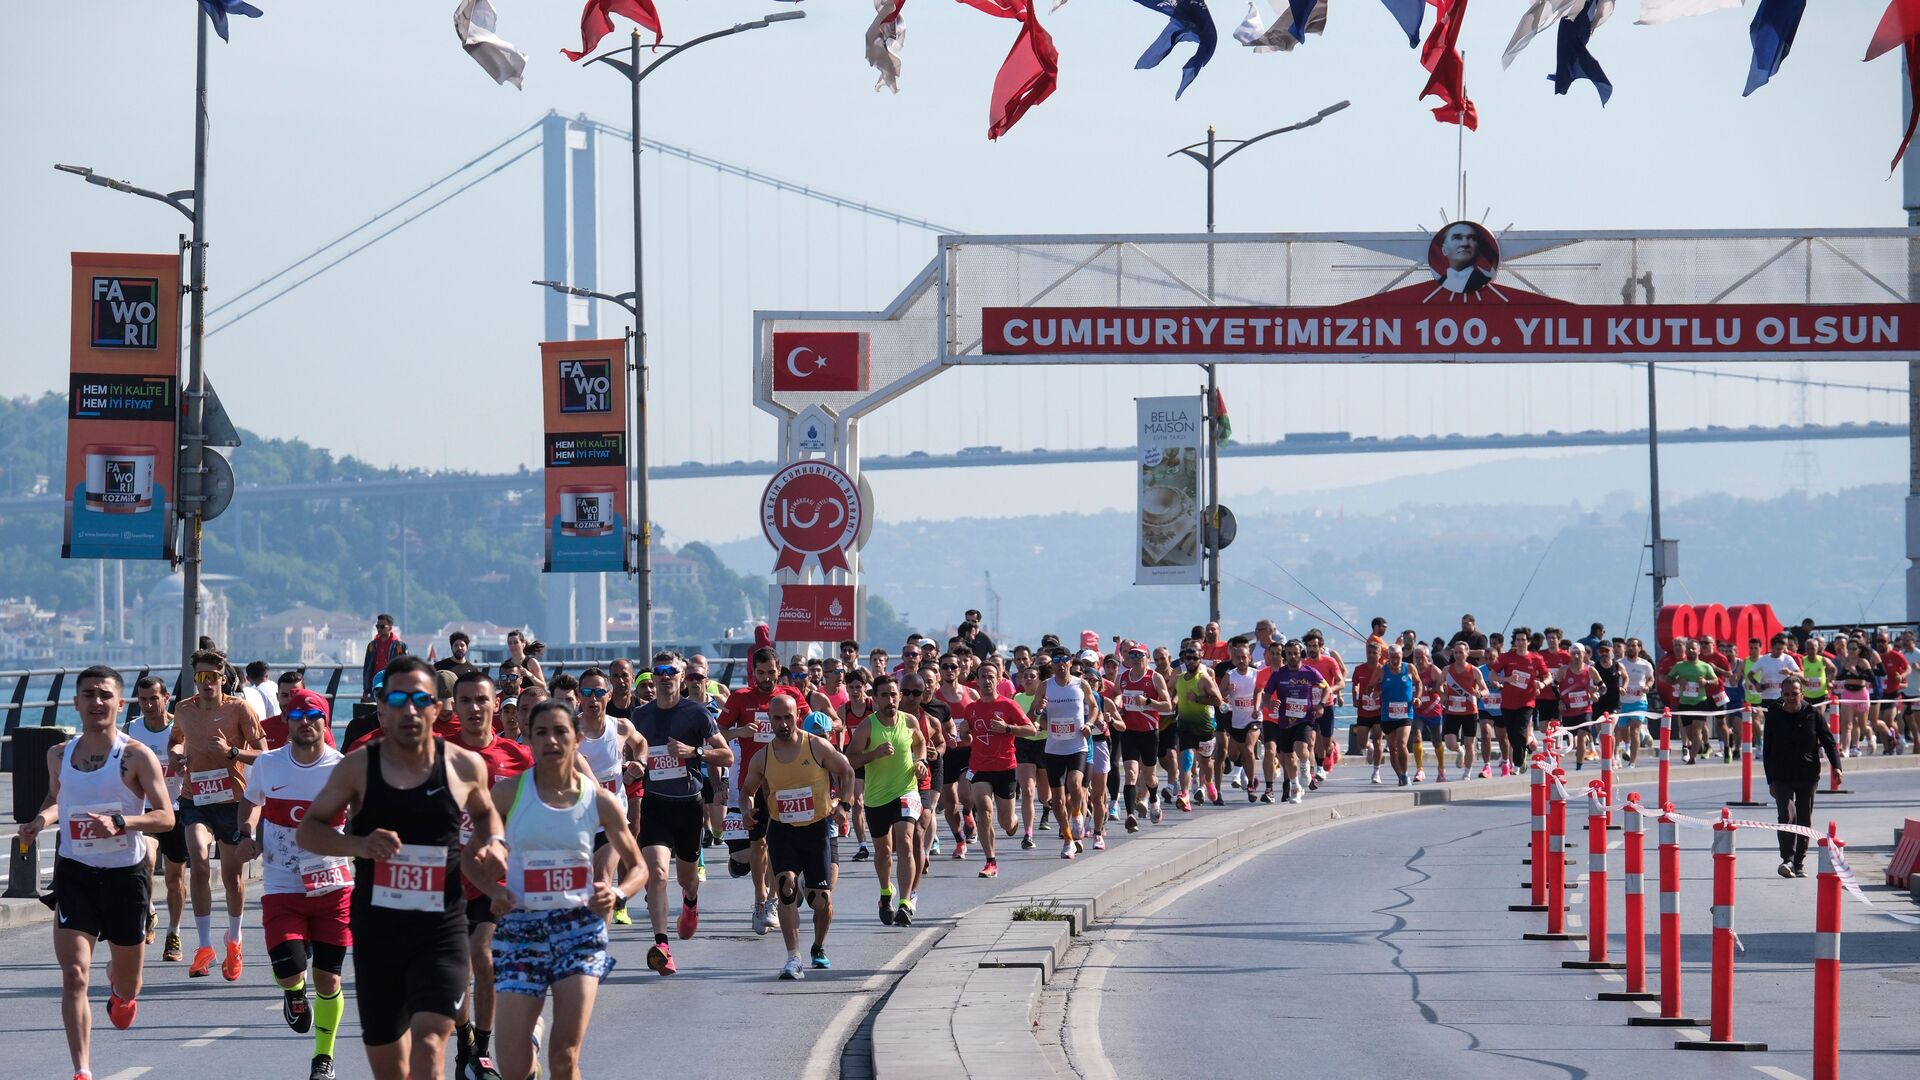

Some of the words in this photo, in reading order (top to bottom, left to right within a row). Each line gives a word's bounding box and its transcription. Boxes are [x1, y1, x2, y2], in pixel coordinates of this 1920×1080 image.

[1415, 317, 1501, 346] 100.
[1514, 318, 1592, 346] YILI
[1607, 317, 1741, 345] KUTLU
[1755, 315, 1899, 345] OLSUN
[83, 385, 108, 395] HEM
[109, 383, 123, 396] İYİ
[125, 384, 162, 396] KALİTE
[83, 398, 107, 409] HEM
[109, 397, 123, 409] İYİ
[125, 397, 153, 409] FİYAT
[1151, 411, 1188, 422] BELLA
[1144, 422, 1195, 434] MAISON
[556, 441, 575, 449] HEM
[576, 440, 587, 448] İYİ
[588, 439, 617, 448] KALİTE
[556, 451, 575, 459] HEM
[576, 450, 587, 458] İYİ
[589, 450, 610, 458] FİYAT
[782, 467, 843, 485] CUMHURİYET
[653, 755, 679, 770] 2688
[198, 779, 224, 794] 3441
[782, 799, 808, 813] 2211
[311, 867, 344, 888] 2359
[389, 865, 433, 891] 1631
[543, 868, 573, 891] 156
